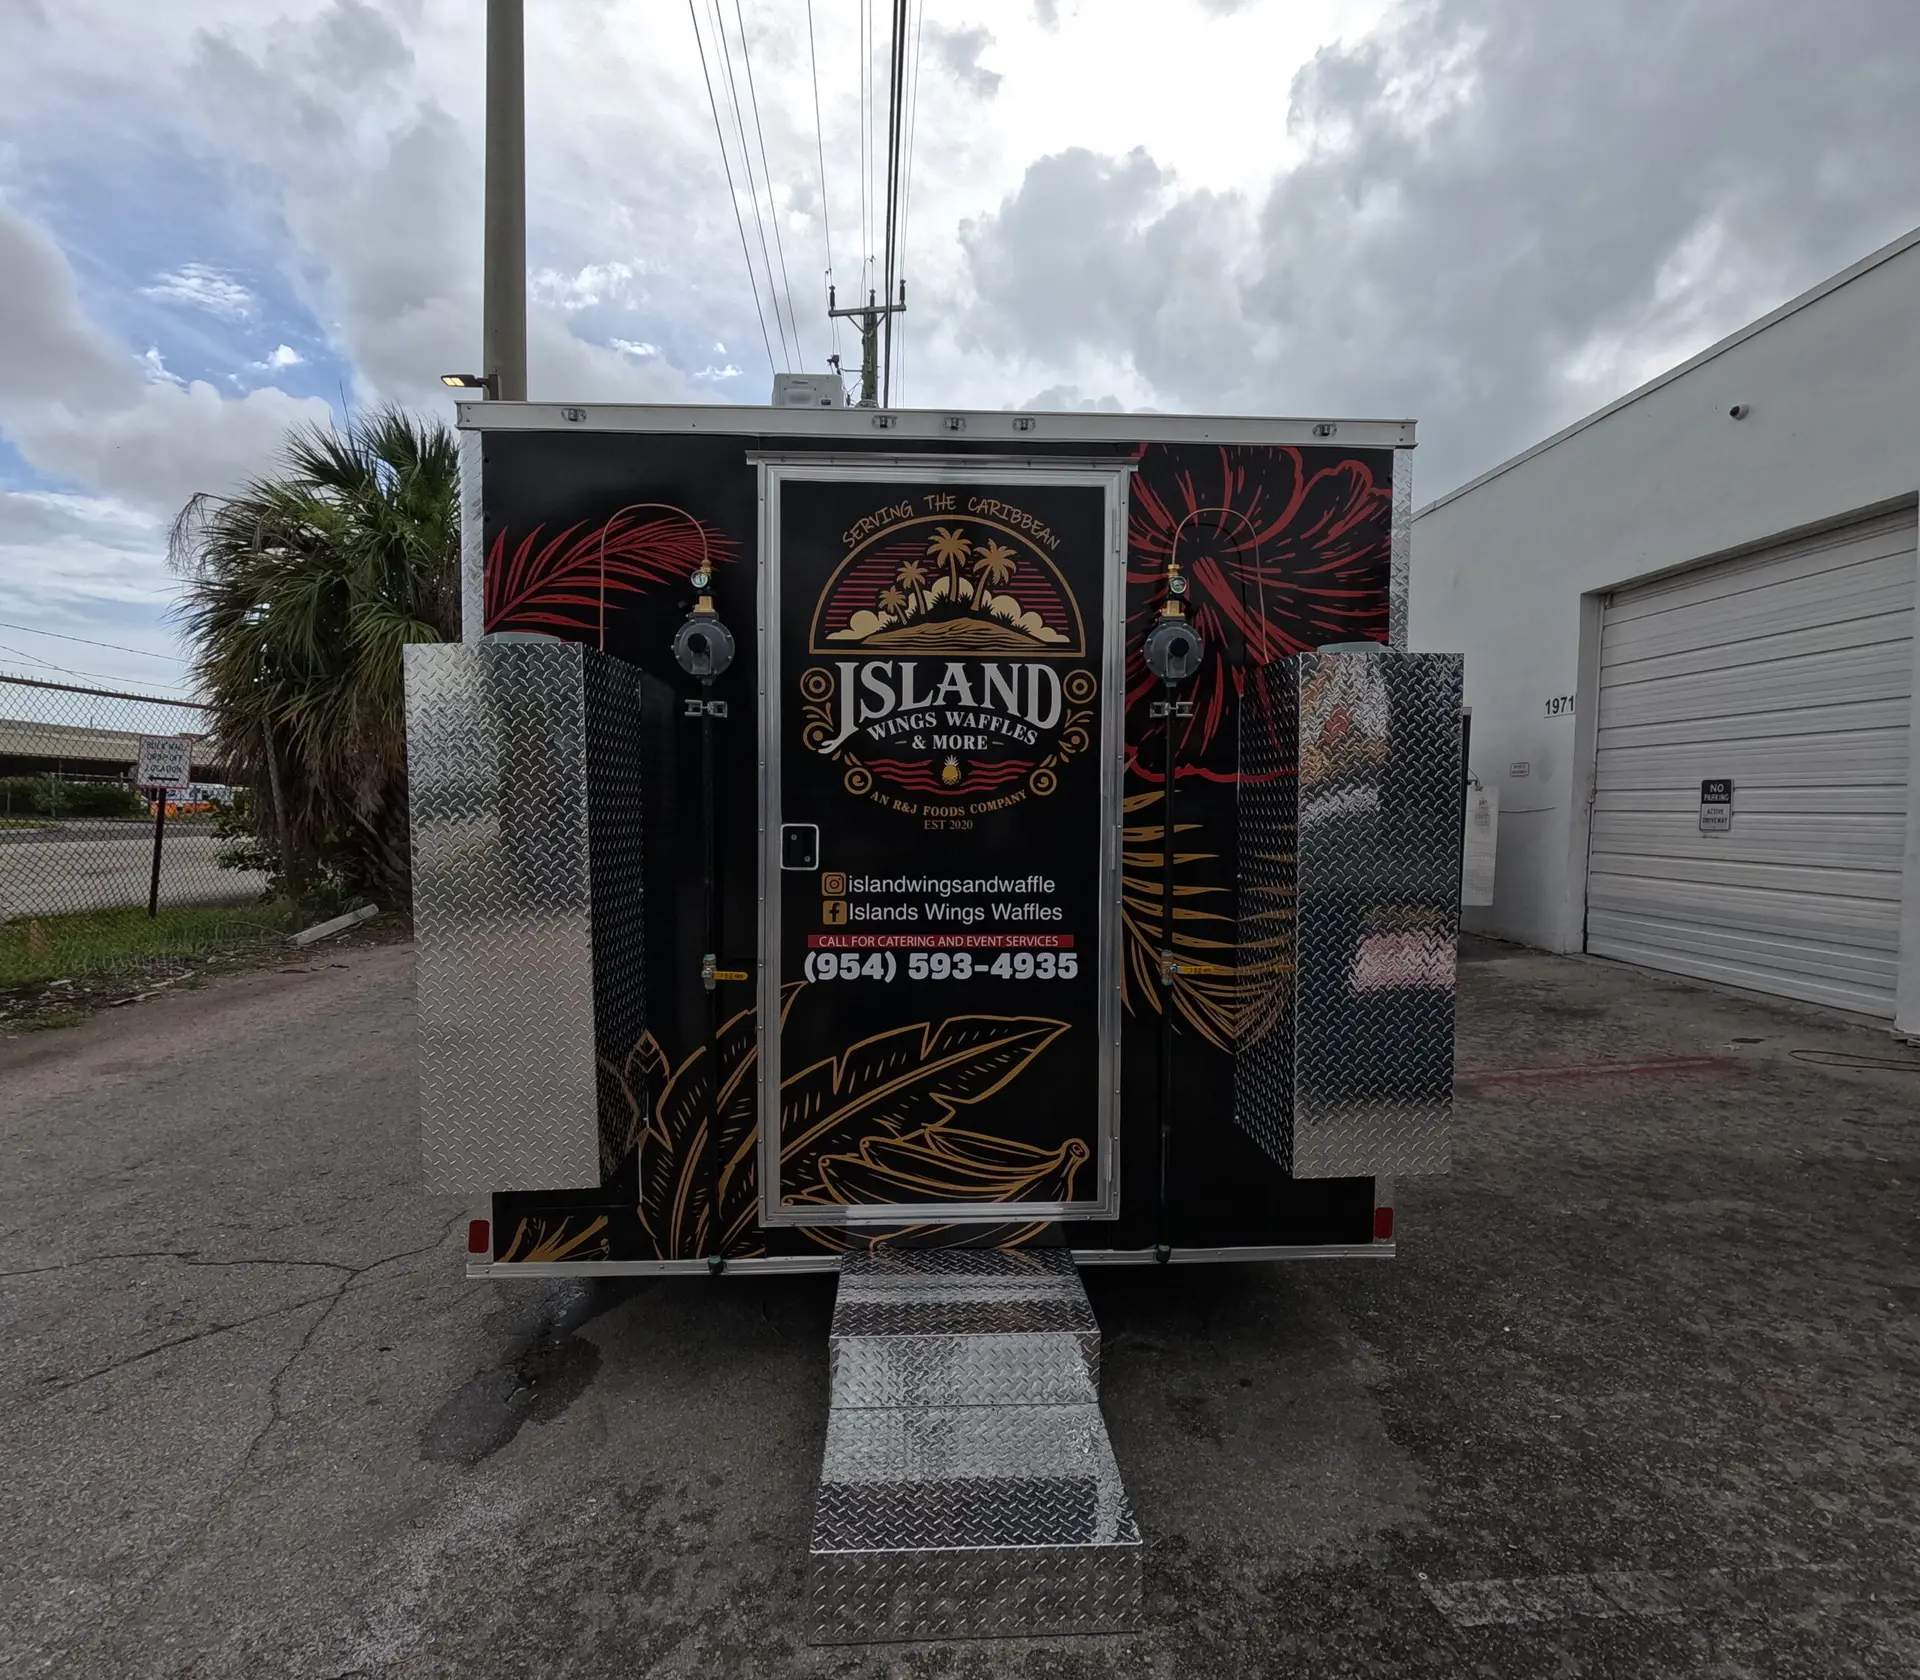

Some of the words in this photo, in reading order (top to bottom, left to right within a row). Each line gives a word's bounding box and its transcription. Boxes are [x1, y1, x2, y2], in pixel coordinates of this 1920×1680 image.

[843, 500, 914, 548] SERVING
[924, 493, 956, 511] THE
[968, 497, 1060, 551] CARIBBEAN
[818, 661, 1062, 754] ISLAND
[1545, 695, 1574, 714] 1971
[867, 711, 936, 741] WINGS
[945, 711, 1038, 745] WAFFLES
[911, 735, 926, 750] &
[933, 735, 988, 750] MORE
[1710, 784, 1724, 793] NO
[870, 791, 889, 806] AN
[892, 800, 917, 815] R&J
[923, 805, 965, 817] FOODS
[970, 789, 1028, 814] COMPANY
[924, 820, 946, 830] EST
[949, 820, 973, 830] 2020
[848, 876, 1055, 898] islandwingsandwaffle
[849, 901, 918, 921] Islands
[925, 903, 985, 925] Wings
[991, 903, 1063, 921] Waffles
[819, 936, 849, 947] CALL
[851, 936, 875, 947] FOR
[878, 936, 935, 947] CATERING
[938, 936, 963, 947] AND
[967, 936, 1004, 947] EVENT
[1006, 936, 1058, 947] SERVICES
[804, 951, 897, 984] (954)
[908, 952, 1078, 980] 593-4935
